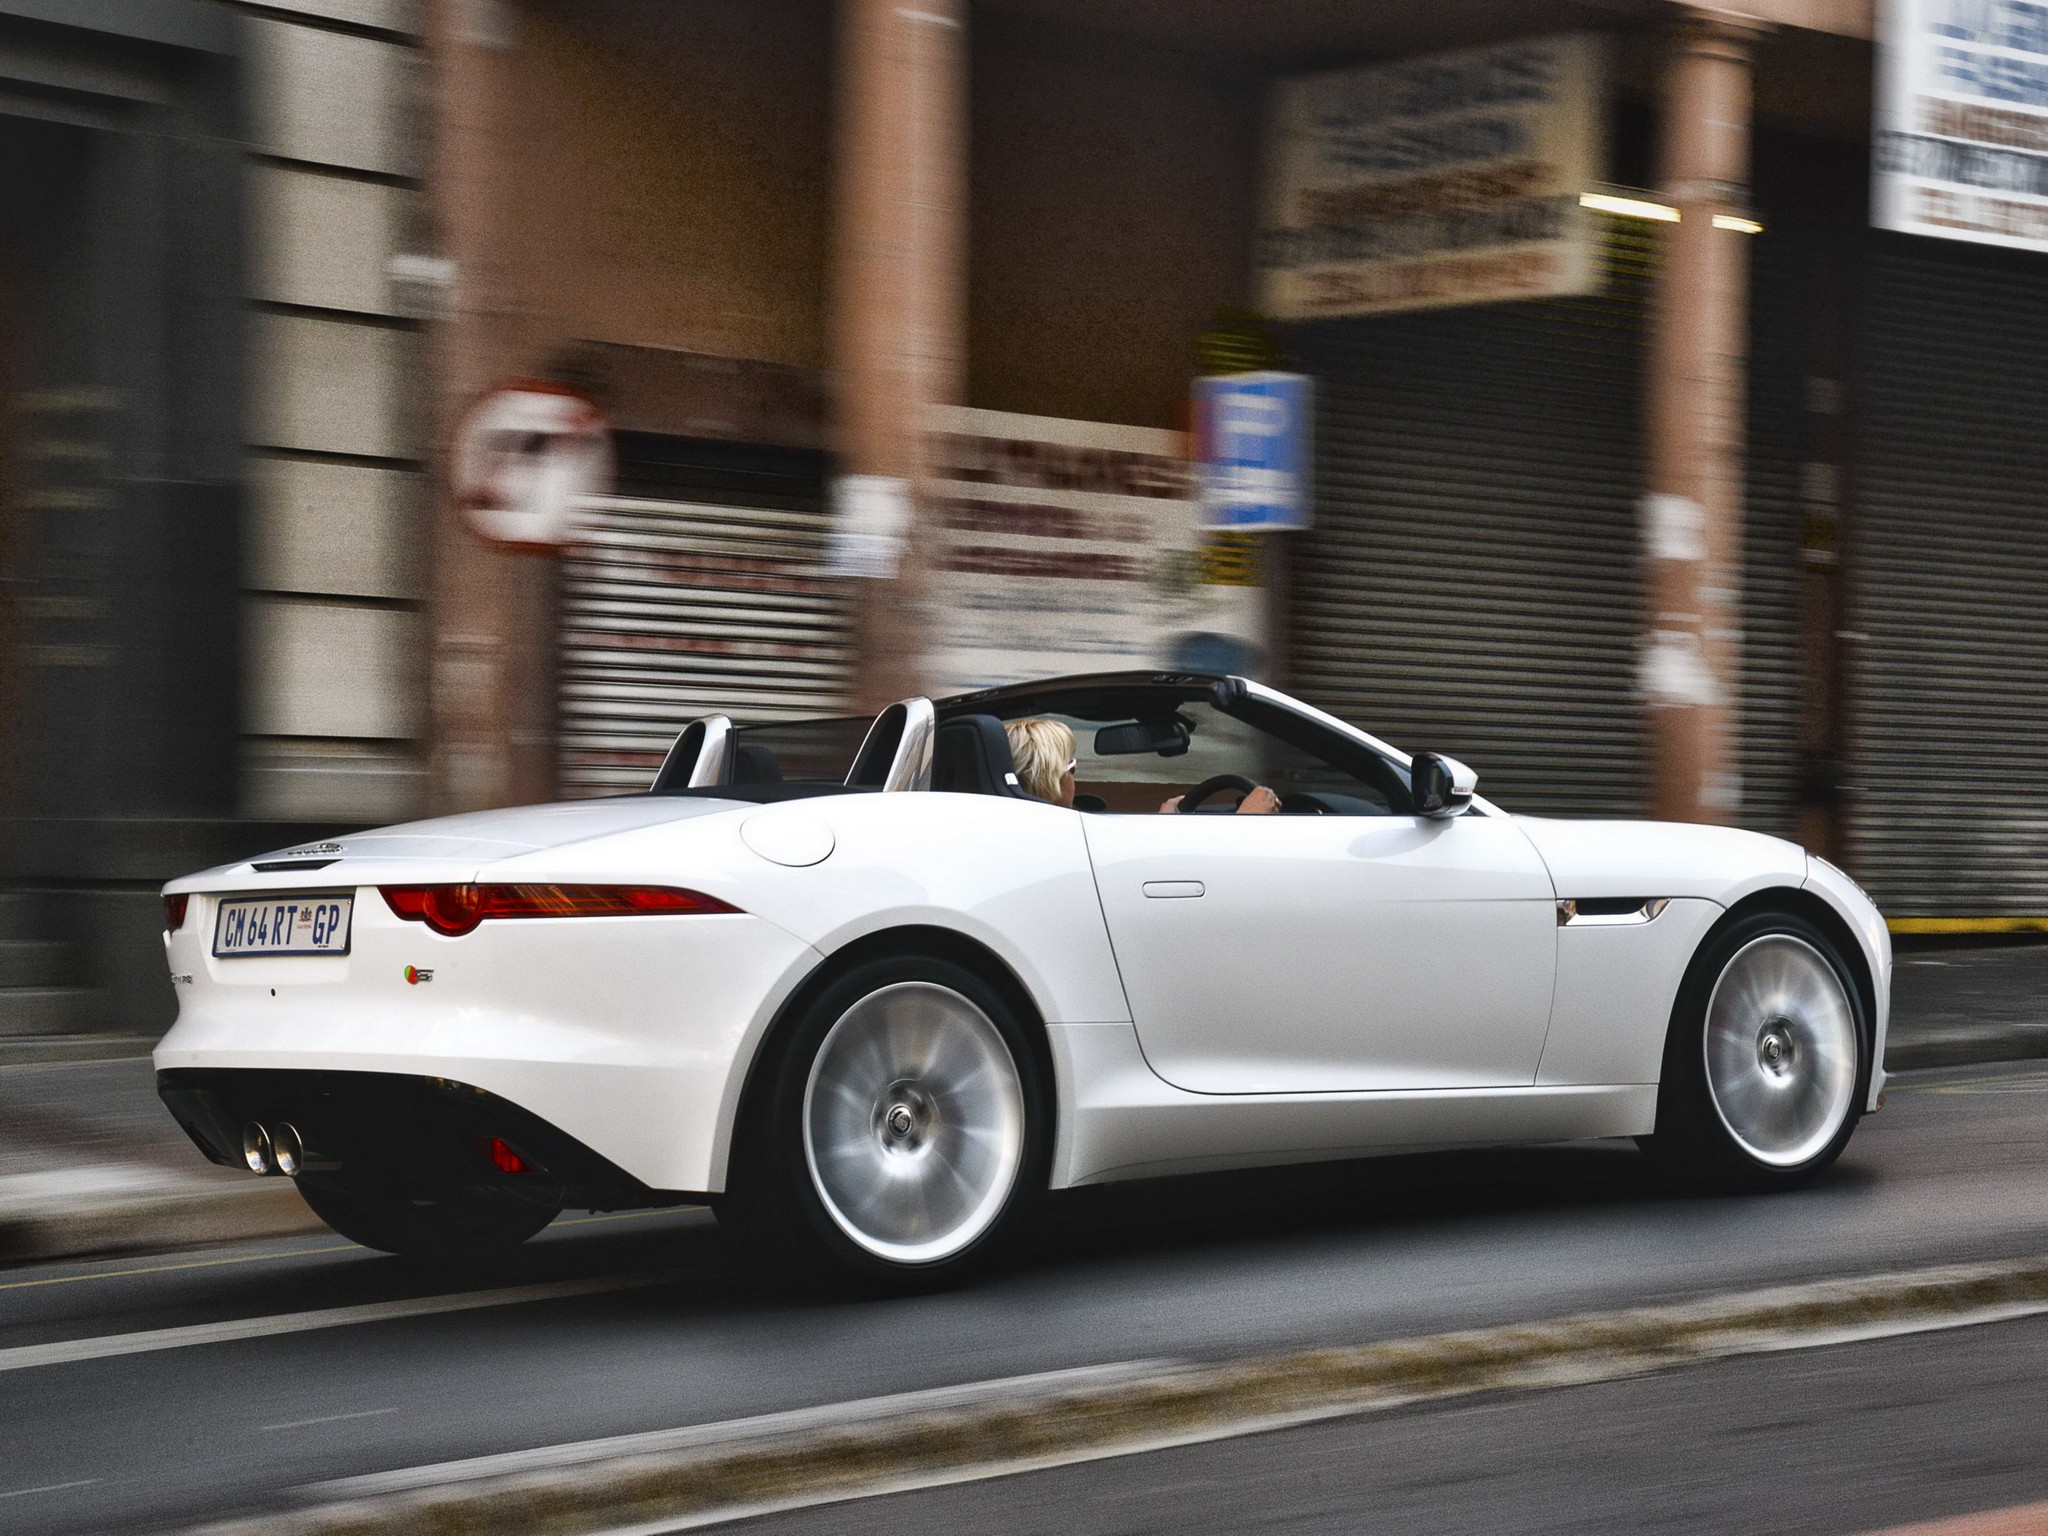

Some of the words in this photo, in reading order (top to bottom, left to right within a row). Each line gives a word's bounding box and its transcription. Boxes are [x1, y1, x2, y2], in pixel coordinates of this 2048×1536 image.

[225, 908, 247, 948] CM
[247, 907, 268, 946] 64
[271, 905, 298, 946] RT
[312, 904, 340, 945] GP
